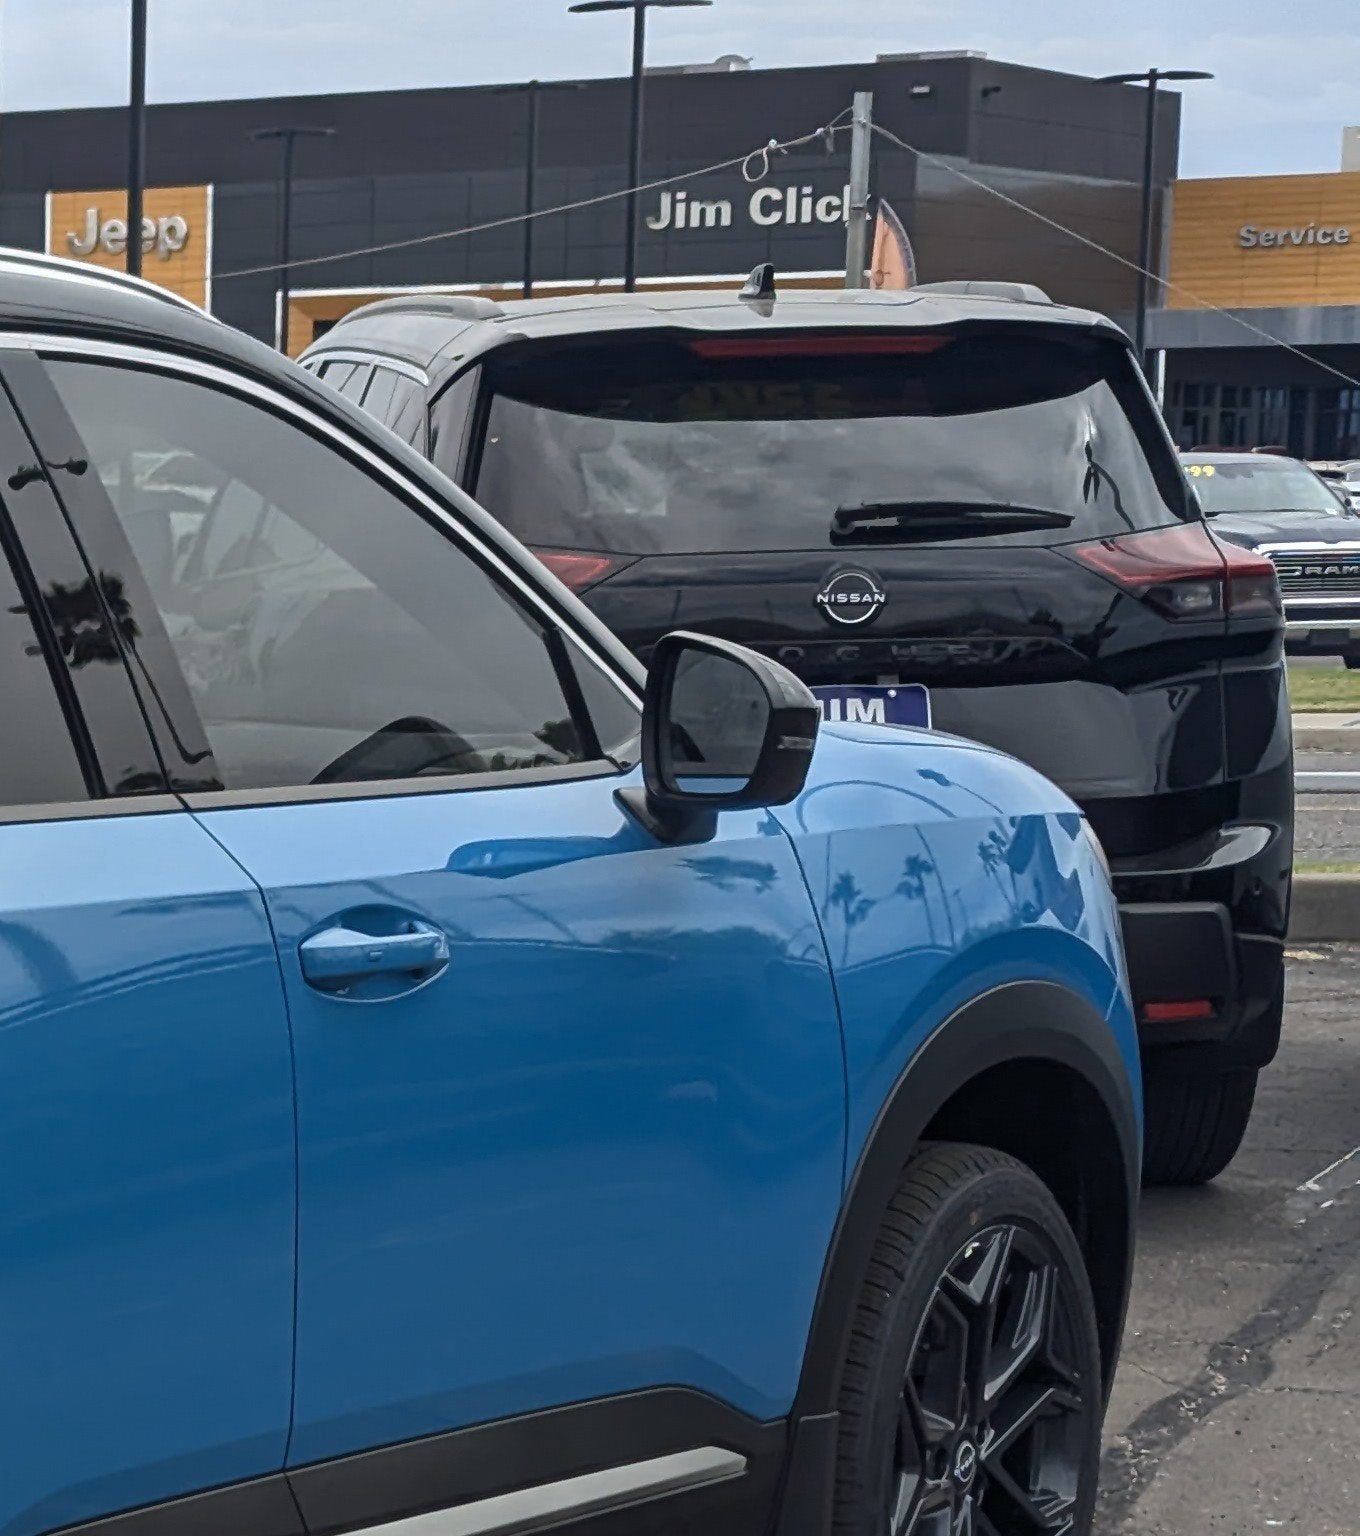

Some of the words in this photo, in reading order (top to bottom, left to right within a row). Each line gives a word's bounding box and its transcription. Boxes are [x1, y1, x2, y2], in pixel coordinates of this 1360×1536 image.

[646, 190, 732, 230] Jim
[67, 207, 189, 262] Jeep
[1238, 222, 1351, 248] Service
[1305, 565, 1360, 576] RAM
[816, 593, 886, 603] NISSAN
[816, 698, 886, 724] IM
